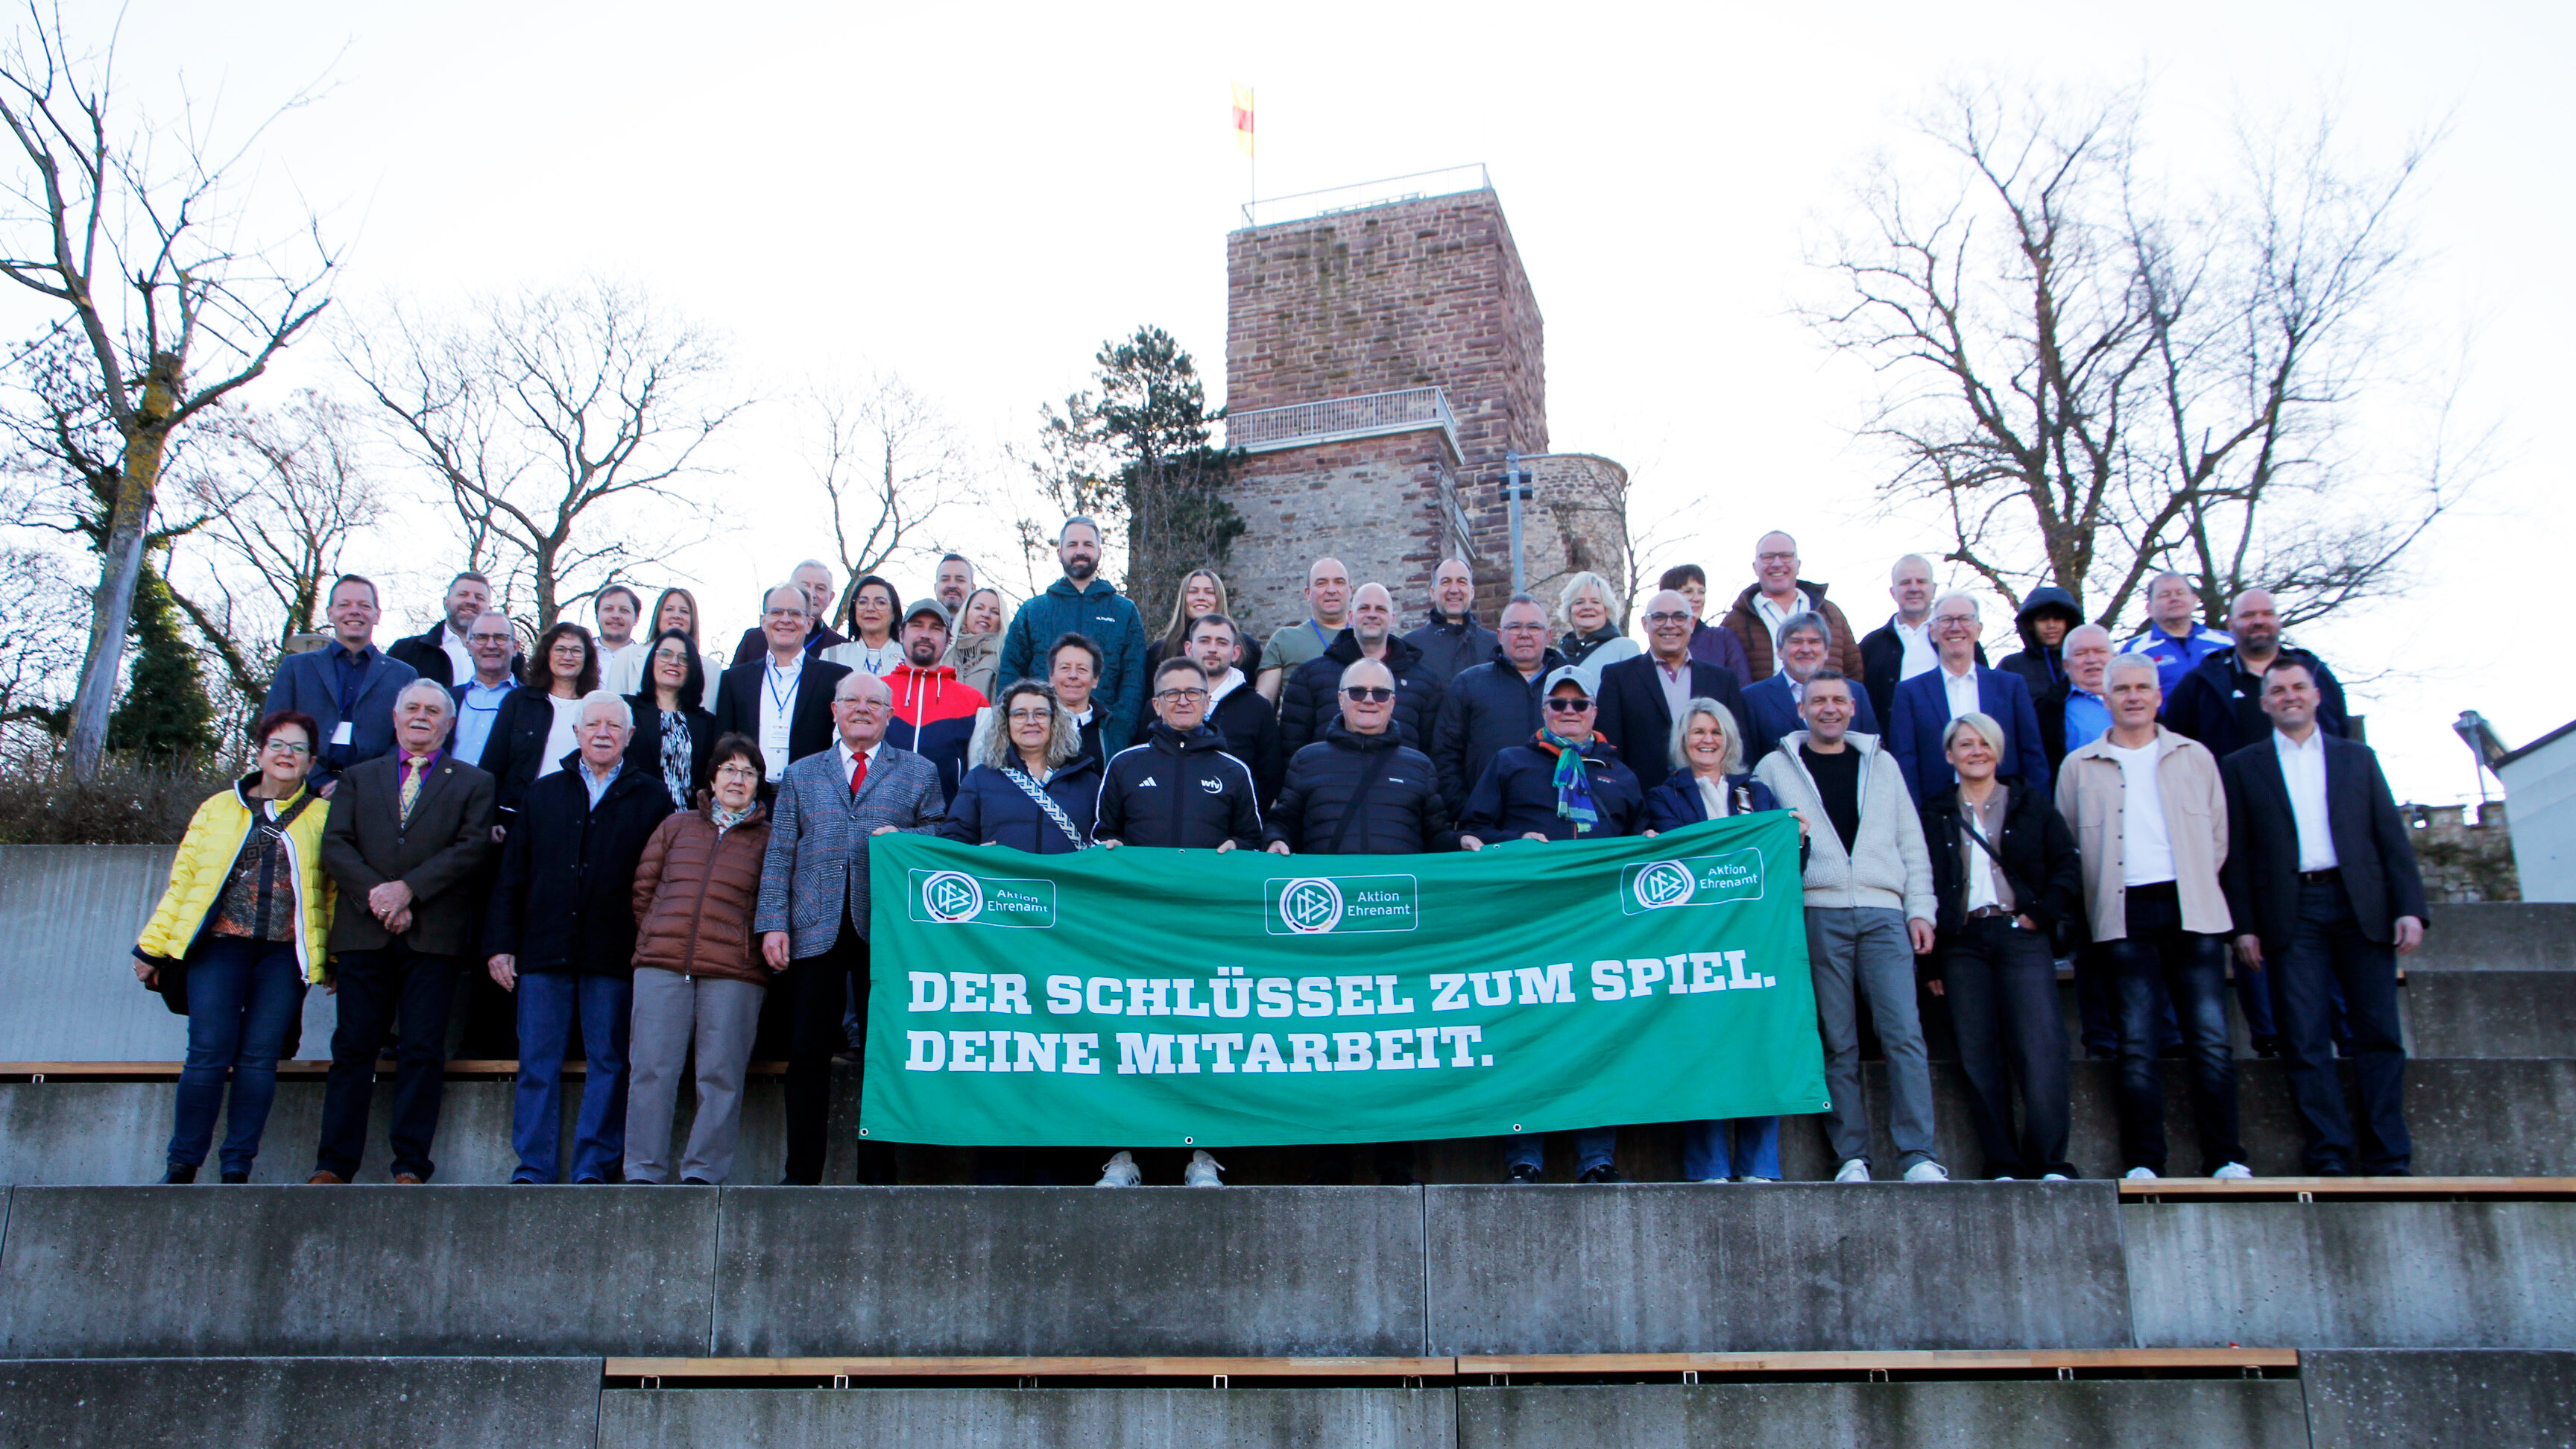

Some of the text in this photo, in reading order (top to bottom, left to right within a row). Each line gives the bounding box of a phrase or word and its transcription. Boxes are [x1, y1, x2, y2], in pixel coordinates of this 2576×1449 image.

[1201, 780, 1220, 789] wfv
[1708, 864, 1746, 876] Aktion
[1699, 874, 1758, 889] Ehrenamt
[997, 890, 1038, 903] Aktion
[1357, 891, 1400, 903] Aktion
[988, 900, 1048, 912] Ehrenamt
[1348, 904, 1410, 916] Ehrenamt
[908, 950, 1776, 1018] DER SCHLÜSSEL ZUM SPIEL.
[905, 1025, 1494, 1074] DEINE MITARBEIT.
